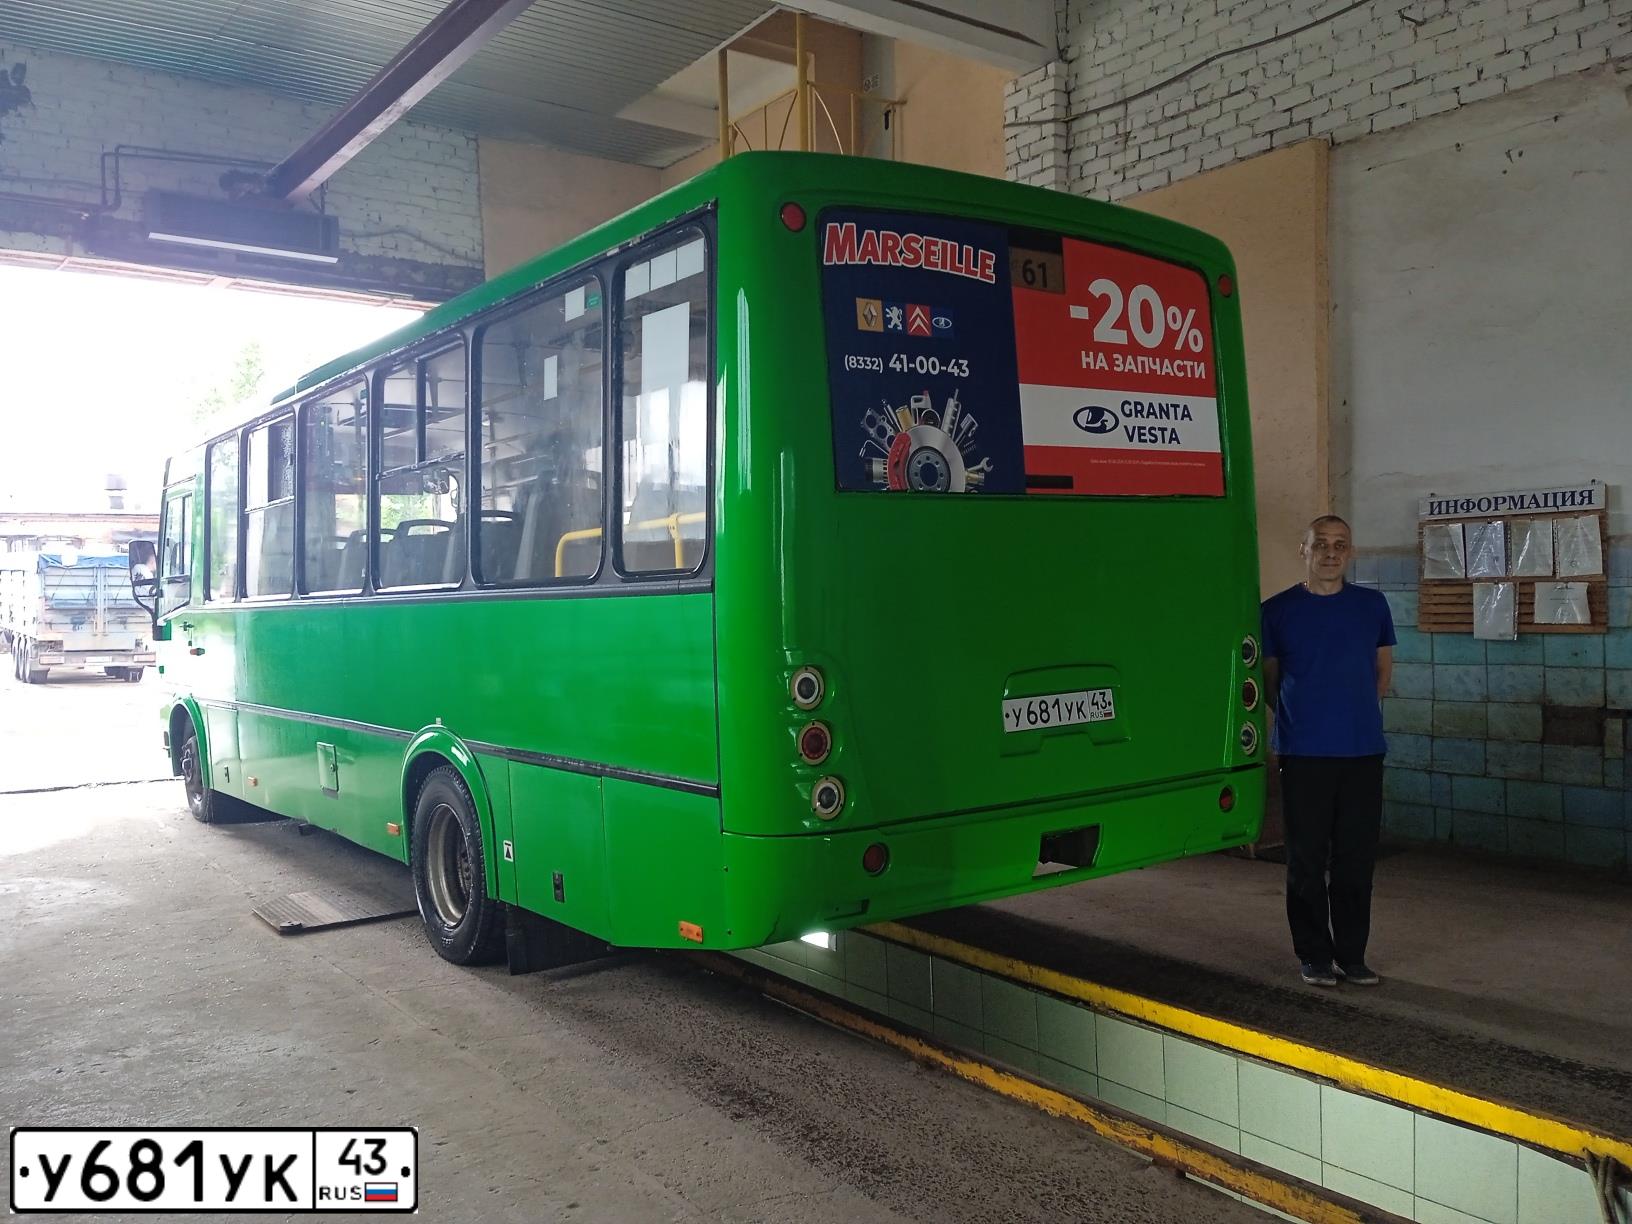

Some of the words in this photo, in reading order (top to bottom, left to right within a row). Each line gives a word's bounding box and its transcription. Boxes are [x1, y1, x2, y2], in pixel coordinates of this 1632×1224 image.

[823, 222, 997, 284] MARSEILLE
[1022, 259, 1047, 289] 61
[1069, 278, 1204, 353] -20%
[844, 354, 884, 374] (8332)
[888, 353, 970, 378] 41-00-43
[1081, 350, 1109, 371] НА
[1112, 353, 1206, 379] ЗАПЧАСТИ
[1120, 400, 1193, 422] GRANTA
[1124, 425, 1181, 446] VESTA
[1428, 488, 1595, 517] ИНФОРМАЦИЯ
[1091, 691, 1107, 711] 43
[1090, 711, 1104, 719] RUS
